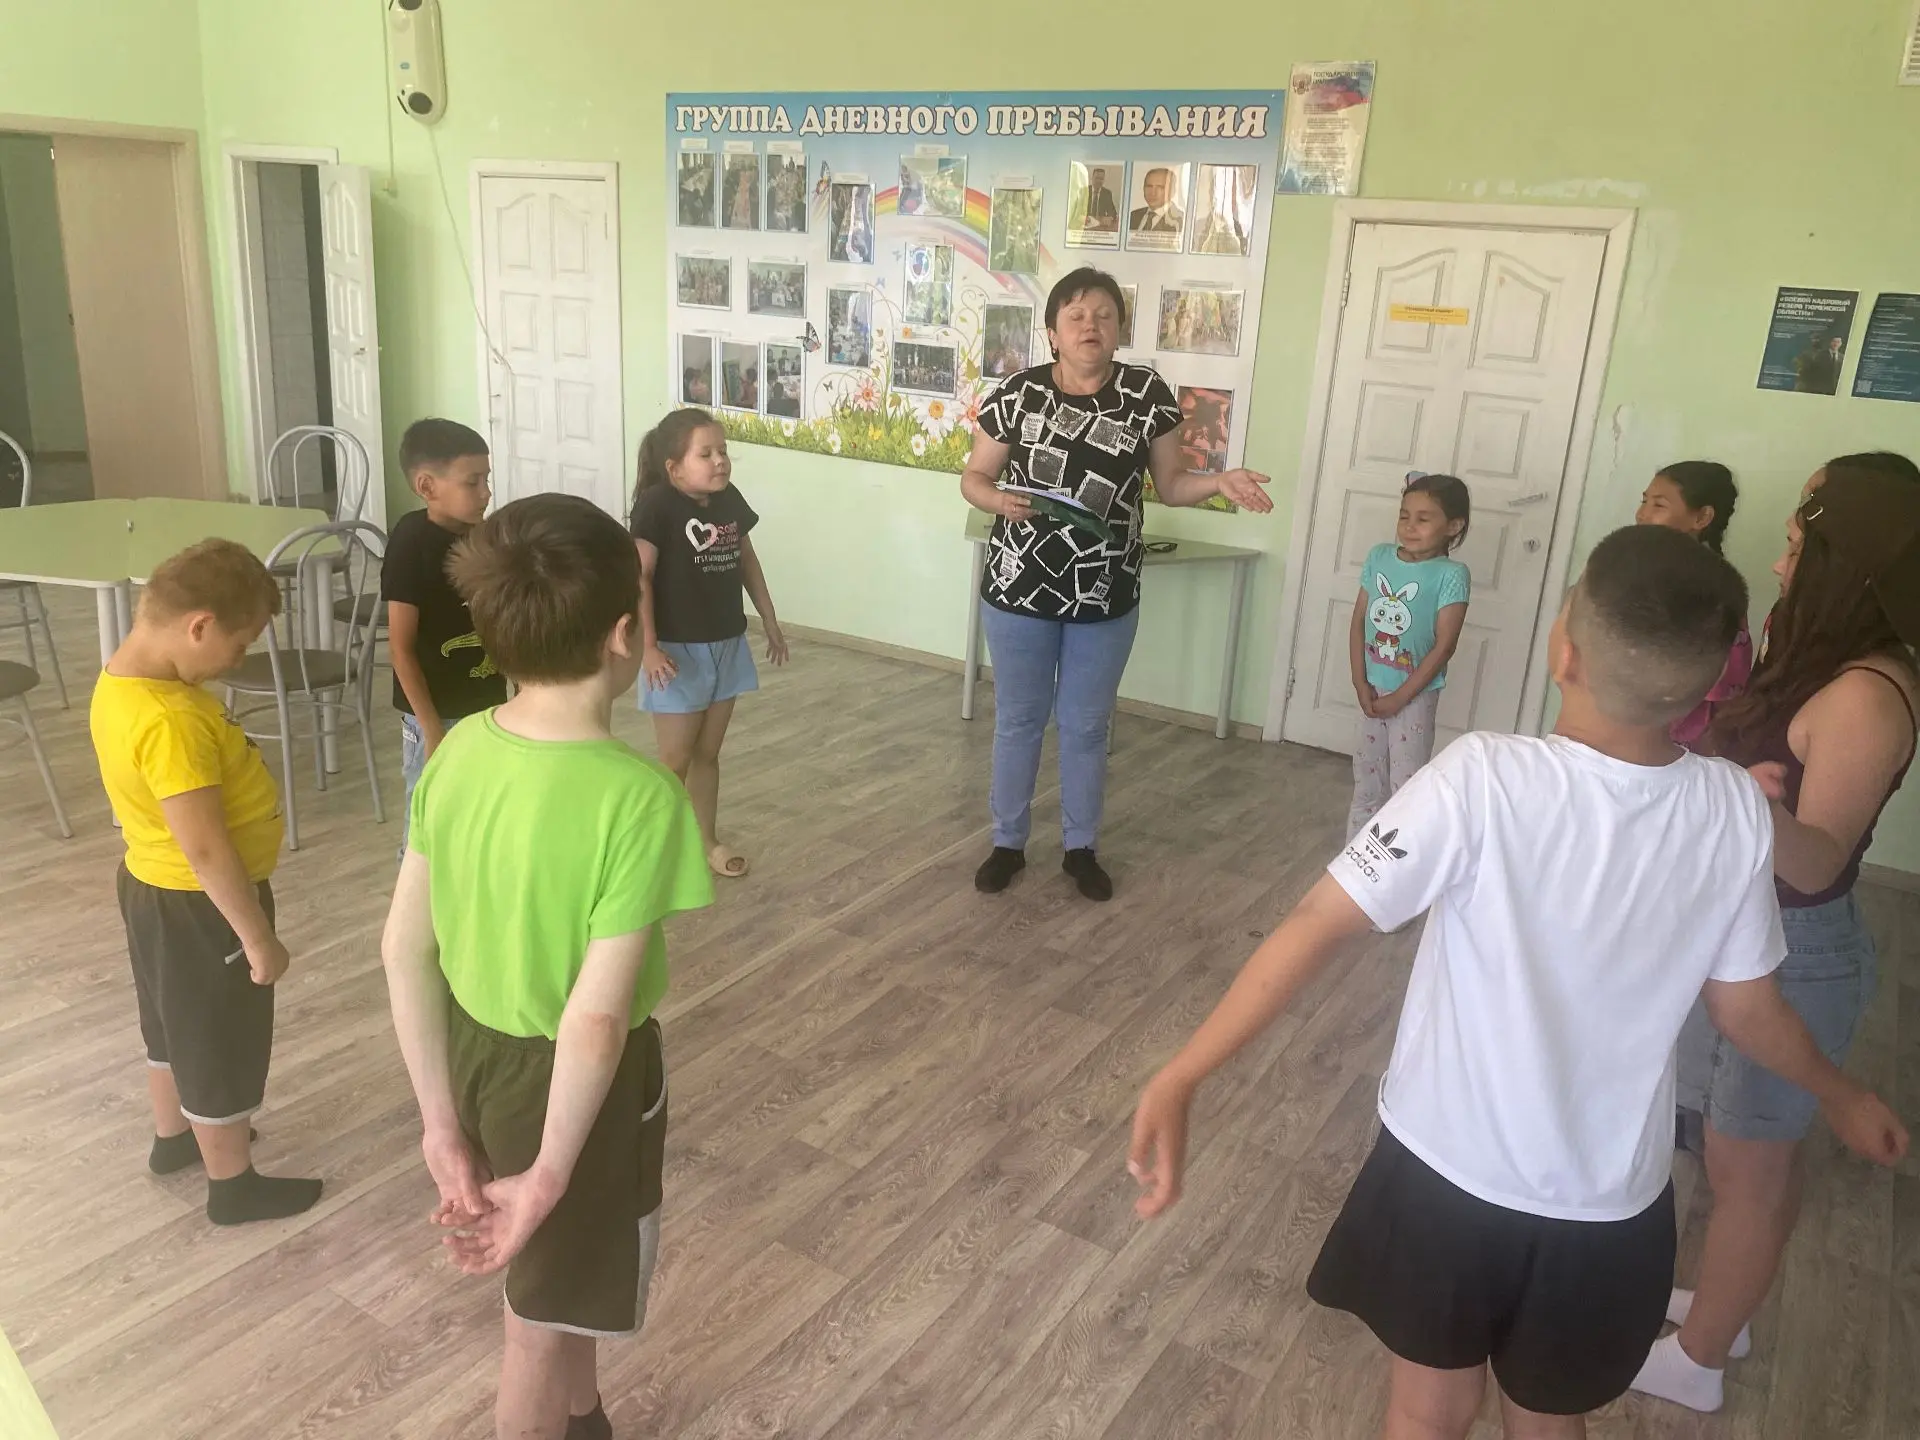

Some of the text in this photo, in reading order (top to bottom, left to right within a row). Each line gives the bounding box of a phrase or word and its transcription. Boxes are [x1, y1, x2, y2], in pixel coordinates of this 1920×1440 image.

[675, 104, 1269, 138] ГРУППА ДНЕВНОГО ПРЕБЫВАНИЯ
[1118, 435, 1135, 450] ME
